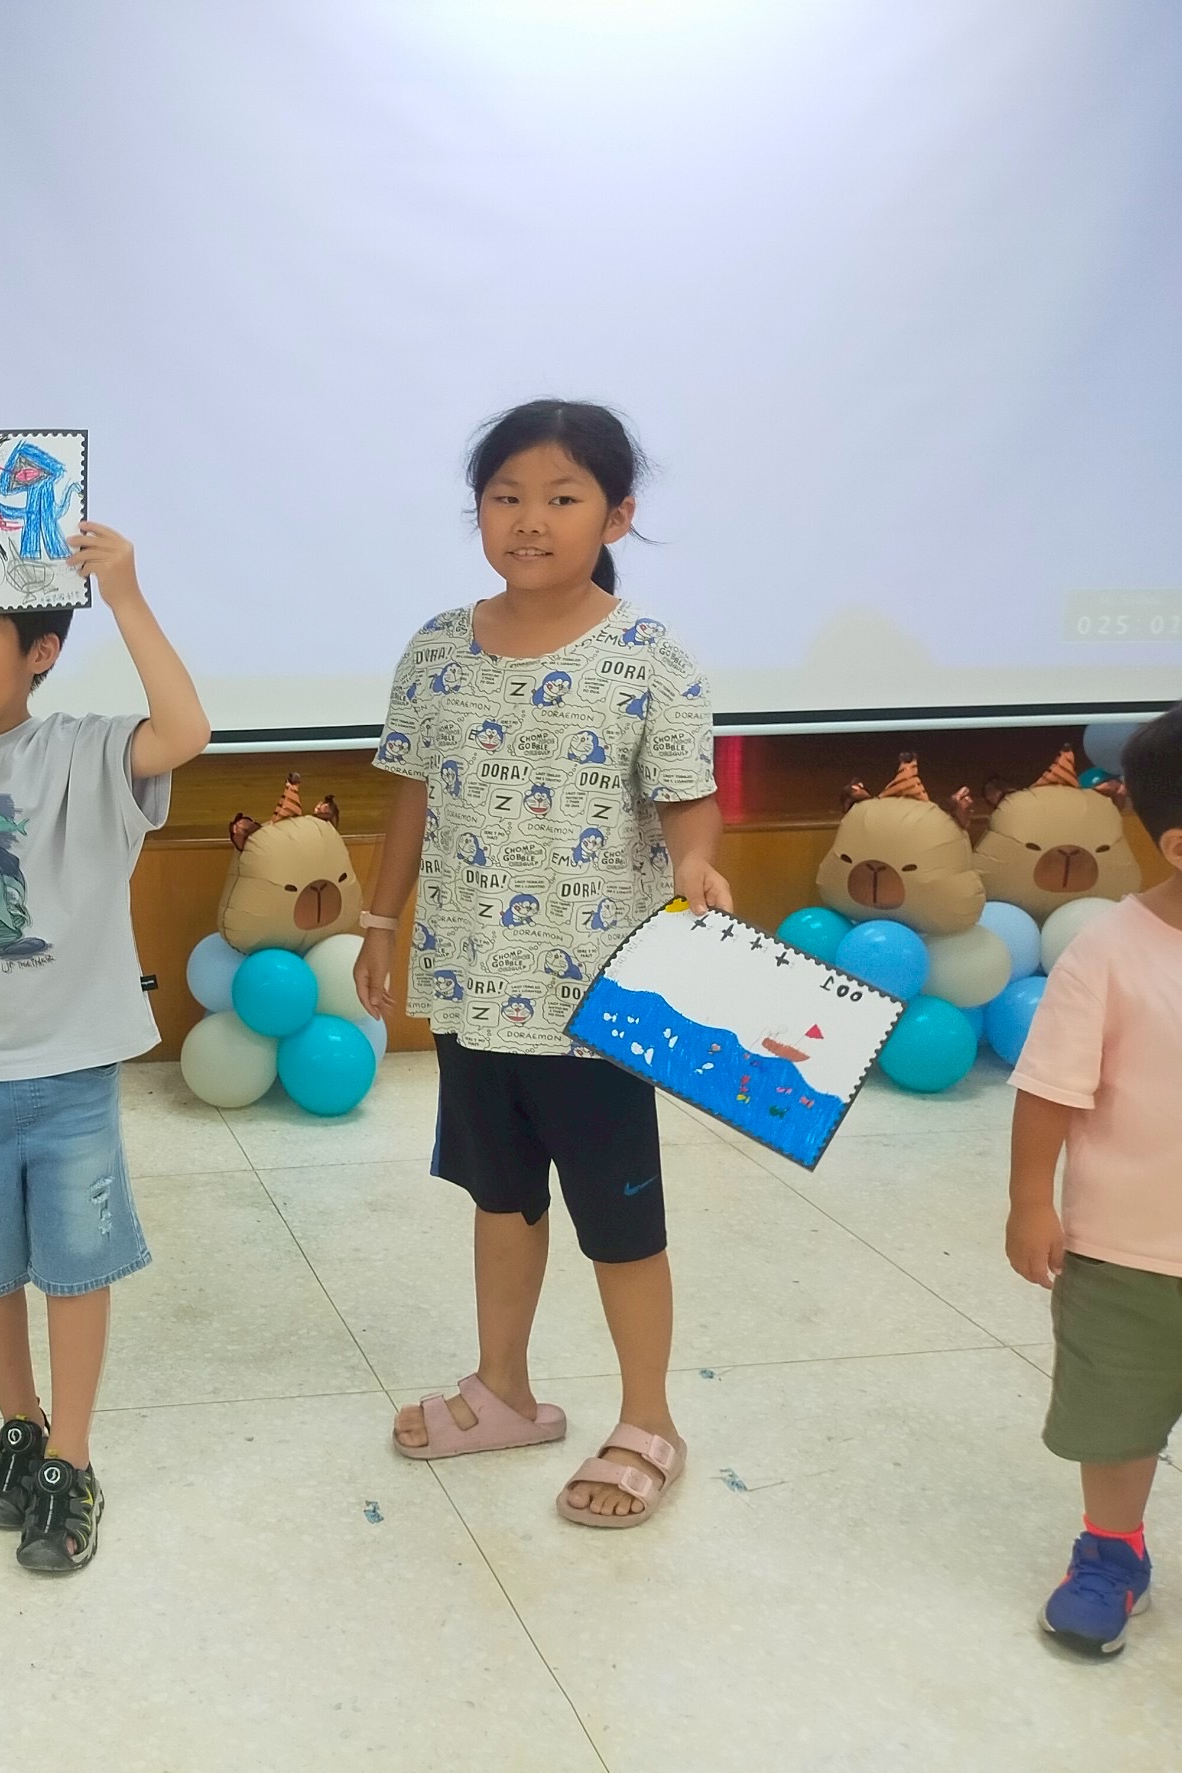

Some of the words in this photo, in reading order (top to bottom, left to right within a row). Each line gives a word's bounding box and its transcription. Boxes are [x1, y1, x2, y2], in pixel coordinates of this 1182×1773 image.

[510, 682, 527, 697] Z
[446, 698, 491, 711] DORAEMON
[541, 710, 595, 722] DORAEMON
[520, 733, 549, 743] CHOMP
[653, 733, 685, 744] CHOMP
[518, 743, 548, 751] GOBBLE
[653, 743, 685, 752] GOBBLE
[481, 763, 529, 781] DORA!
[494, 795, 513, 811] Z
[592, 804, 613, 820] Z
[528, 823, 574, 835] DORAEMON
[505, 845, 536, 855] CHOMP
[503, 854, 535, 862] GOBBLE
[466, 870, 507, 889] DORA!
[561, 881, 601, 897] DORA!
[478, 903, 494, 918] Z
[513, 928, 564, 942] DORAEMON
[492, 950, 523, 961] CHOMP
[491, 960, 523, 968] GOBBLE
[472, 1007, 490, 1020] Z
[507, 1031, 562, 1042] DORAEMON
